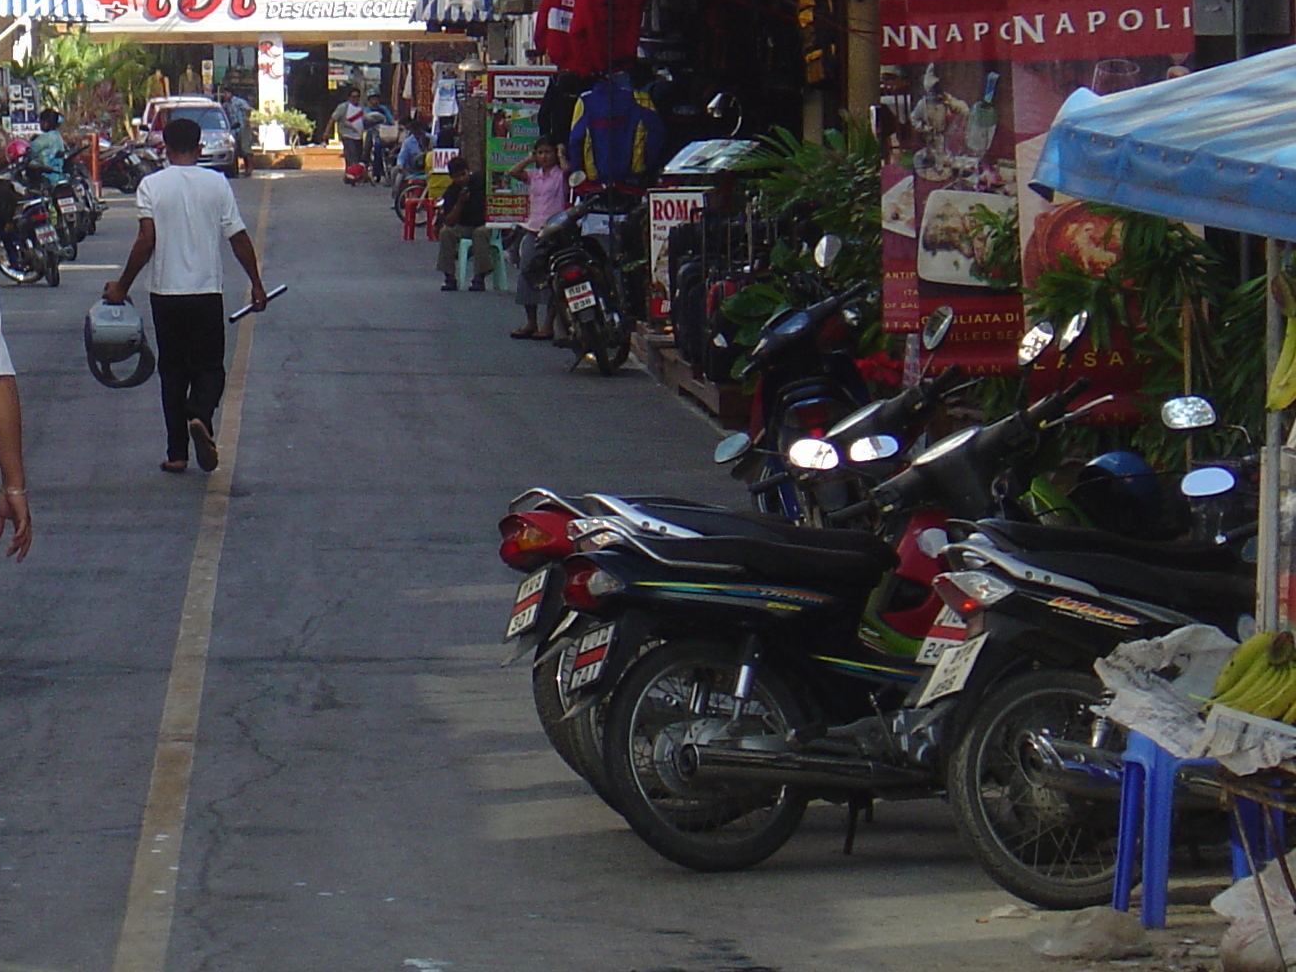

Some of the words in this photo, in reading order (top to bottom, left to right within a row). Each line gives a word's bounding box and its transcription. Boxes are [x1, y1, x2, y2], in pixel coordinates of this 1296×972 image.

[266, 1, 358, 19] DESIGNER
[1013, 5, 1192, 45] NAPOLI
[498, 78, 545, 88] PATONG
[652, 199, 701, 221] ROMA
[884, 271, 919, 280] ANTIP
[1006, 312, 1021, 323] DI
